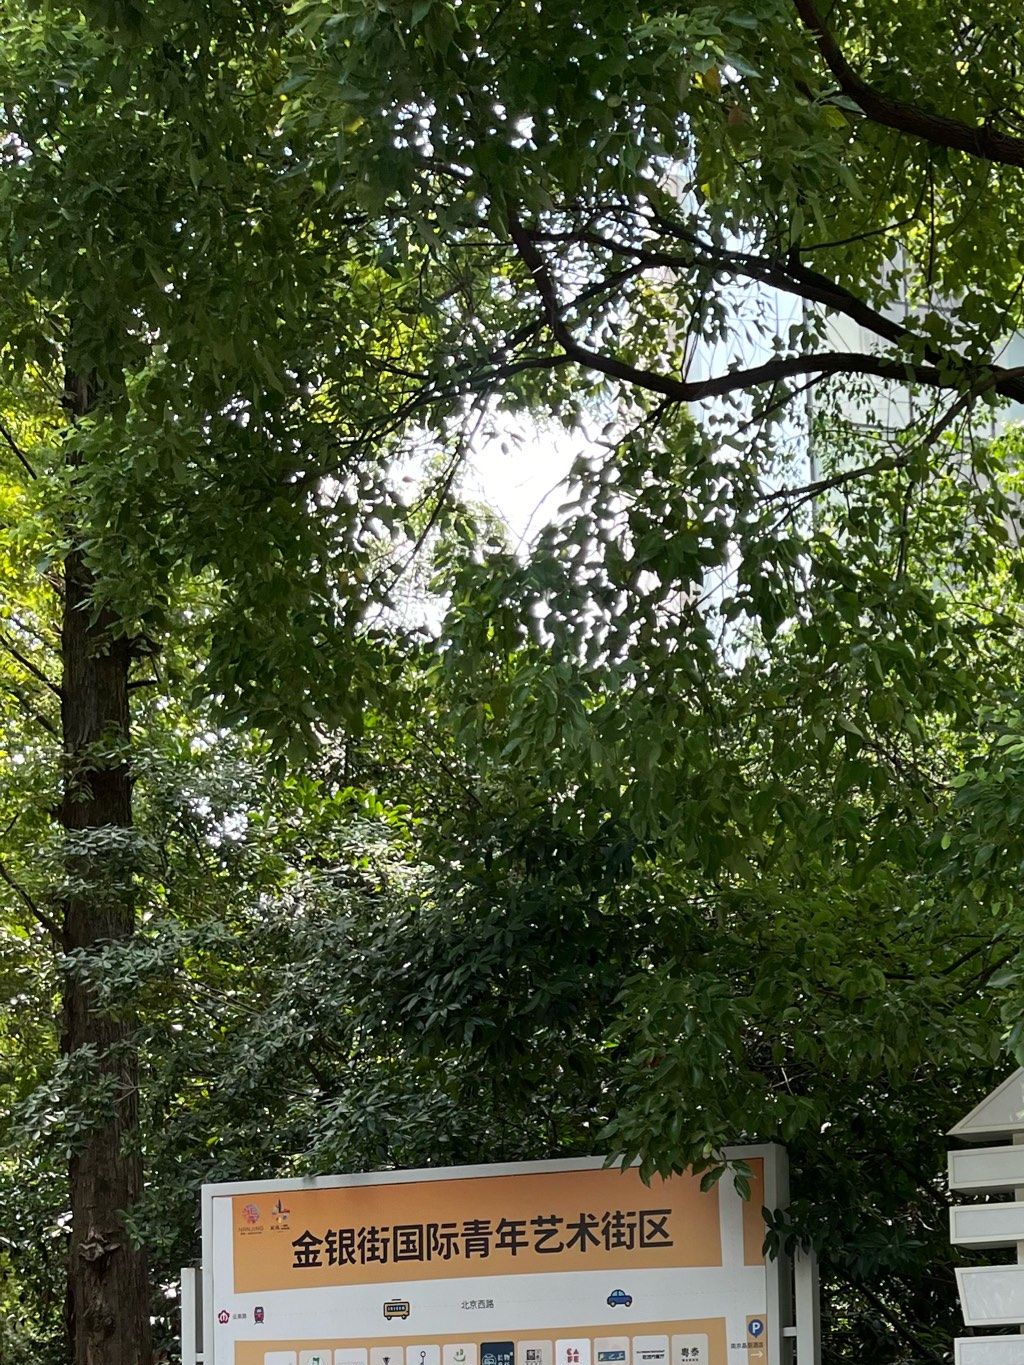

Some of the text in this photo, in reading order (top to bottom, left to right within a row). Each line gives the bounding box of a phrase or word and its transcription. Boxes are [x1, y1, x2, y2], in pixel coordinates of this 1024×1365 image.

[291, 1209, 674, 1268] 金银街国际青年艺术街区
[460, 1299, 495, 1310] 北京西路
